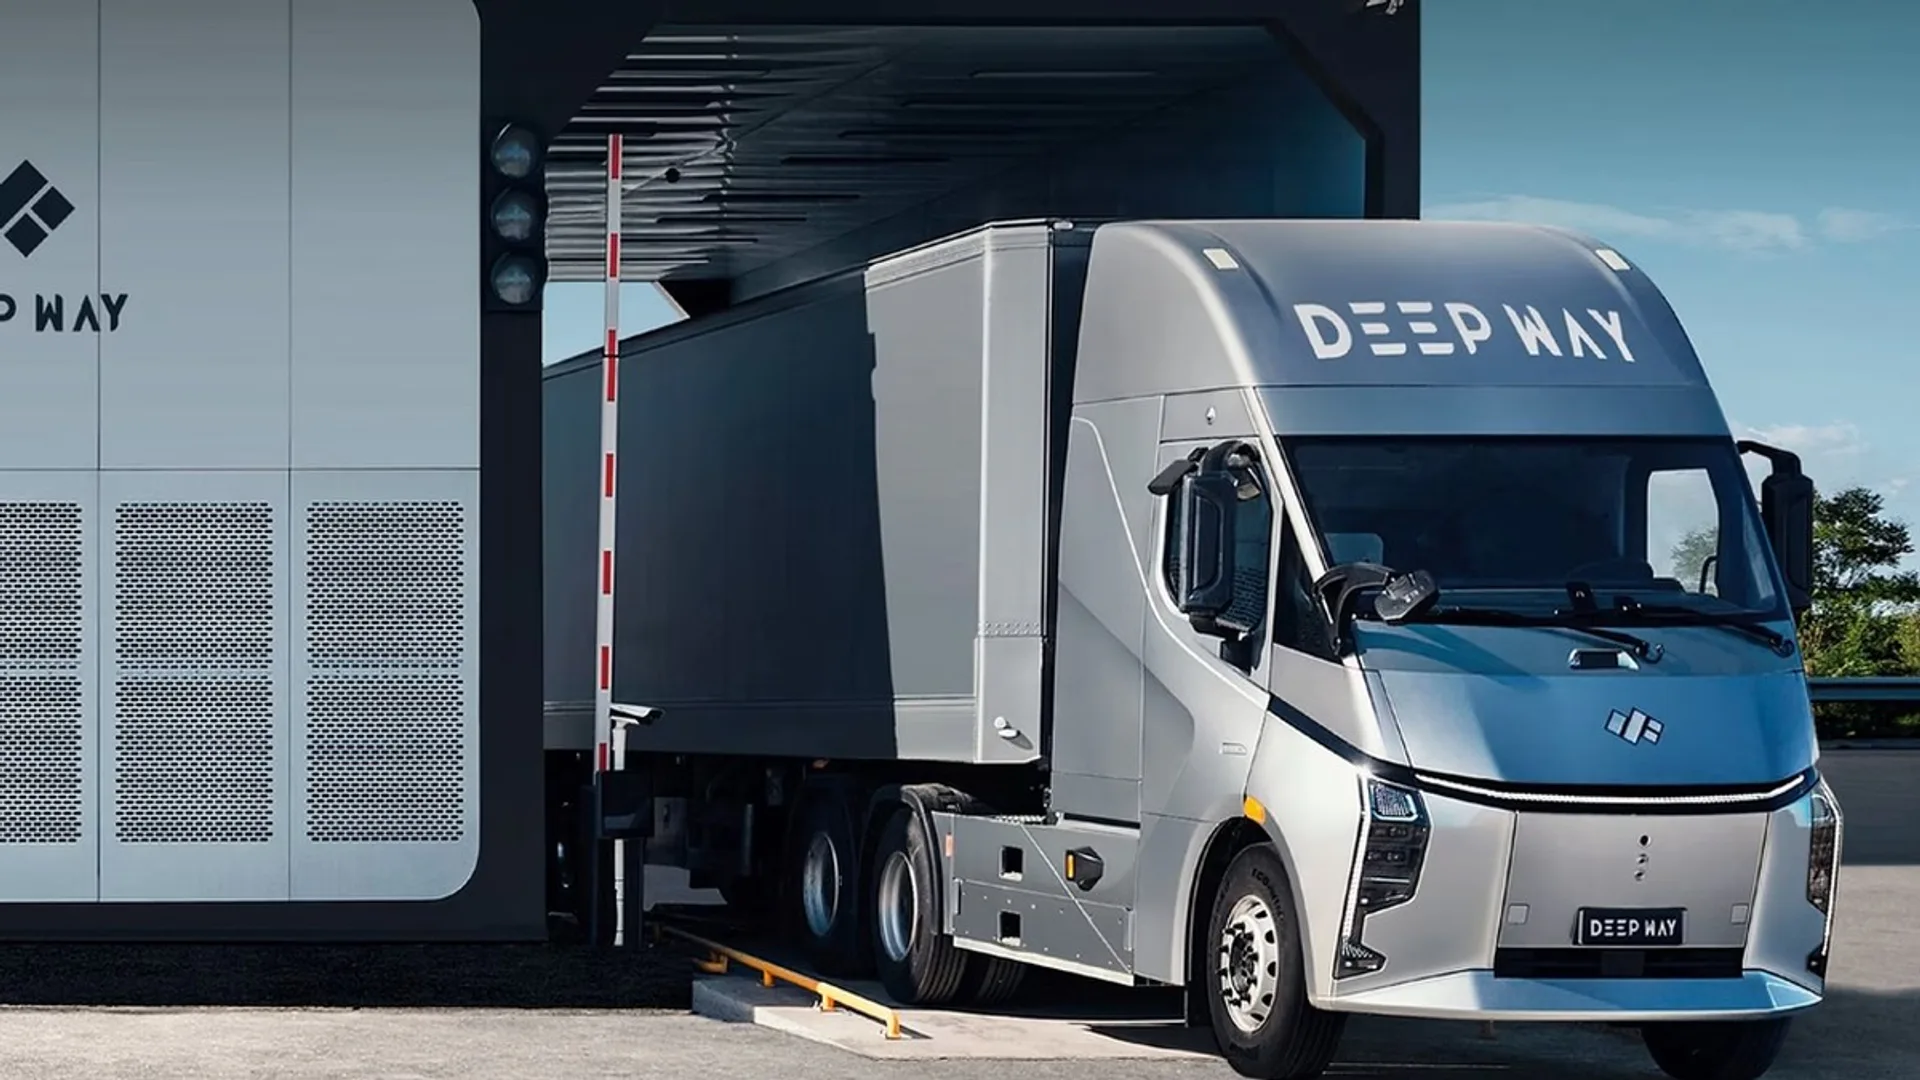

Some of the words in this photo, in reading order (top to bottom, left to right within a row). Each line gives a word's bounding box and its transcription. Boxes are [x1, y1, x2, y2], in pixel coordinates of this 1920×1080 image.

[35, 293, 129, 332] WAY
[1293, 301, 1493, 360] DEEP
[1501, 303, 1636, 363] WAY
[1590, 919, 1640, 937] DEEP
[1645, 919, 1677, 937] WAY
